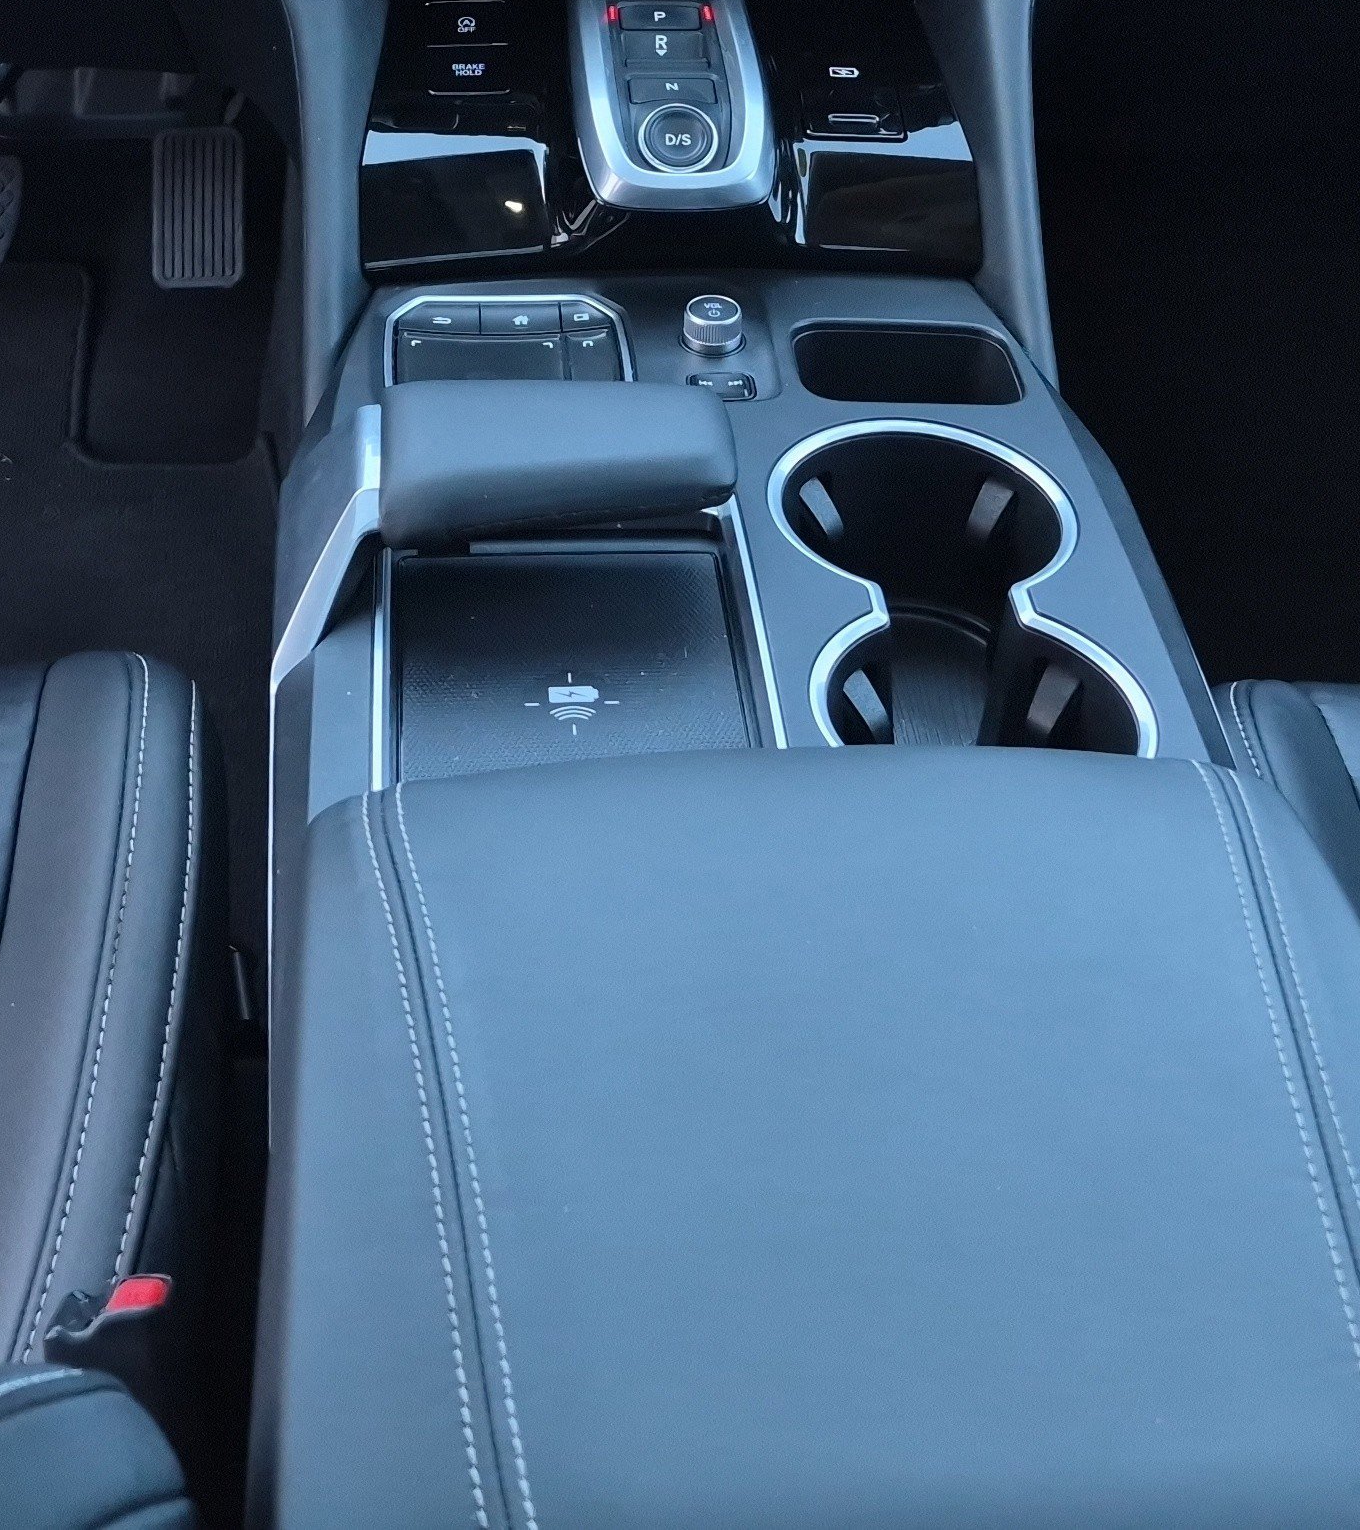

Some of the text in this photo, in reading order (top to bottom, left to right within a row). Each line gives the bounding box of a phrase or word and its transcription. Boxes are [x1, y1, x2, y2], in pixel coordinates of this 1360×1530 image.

[653, 11, 667, 22] P
[655, 34, 668, 50] R
[455, 69, 483, 77] HOLD
[665, 82, 679, 91] N
[665, 133, 692, 146] D/S
